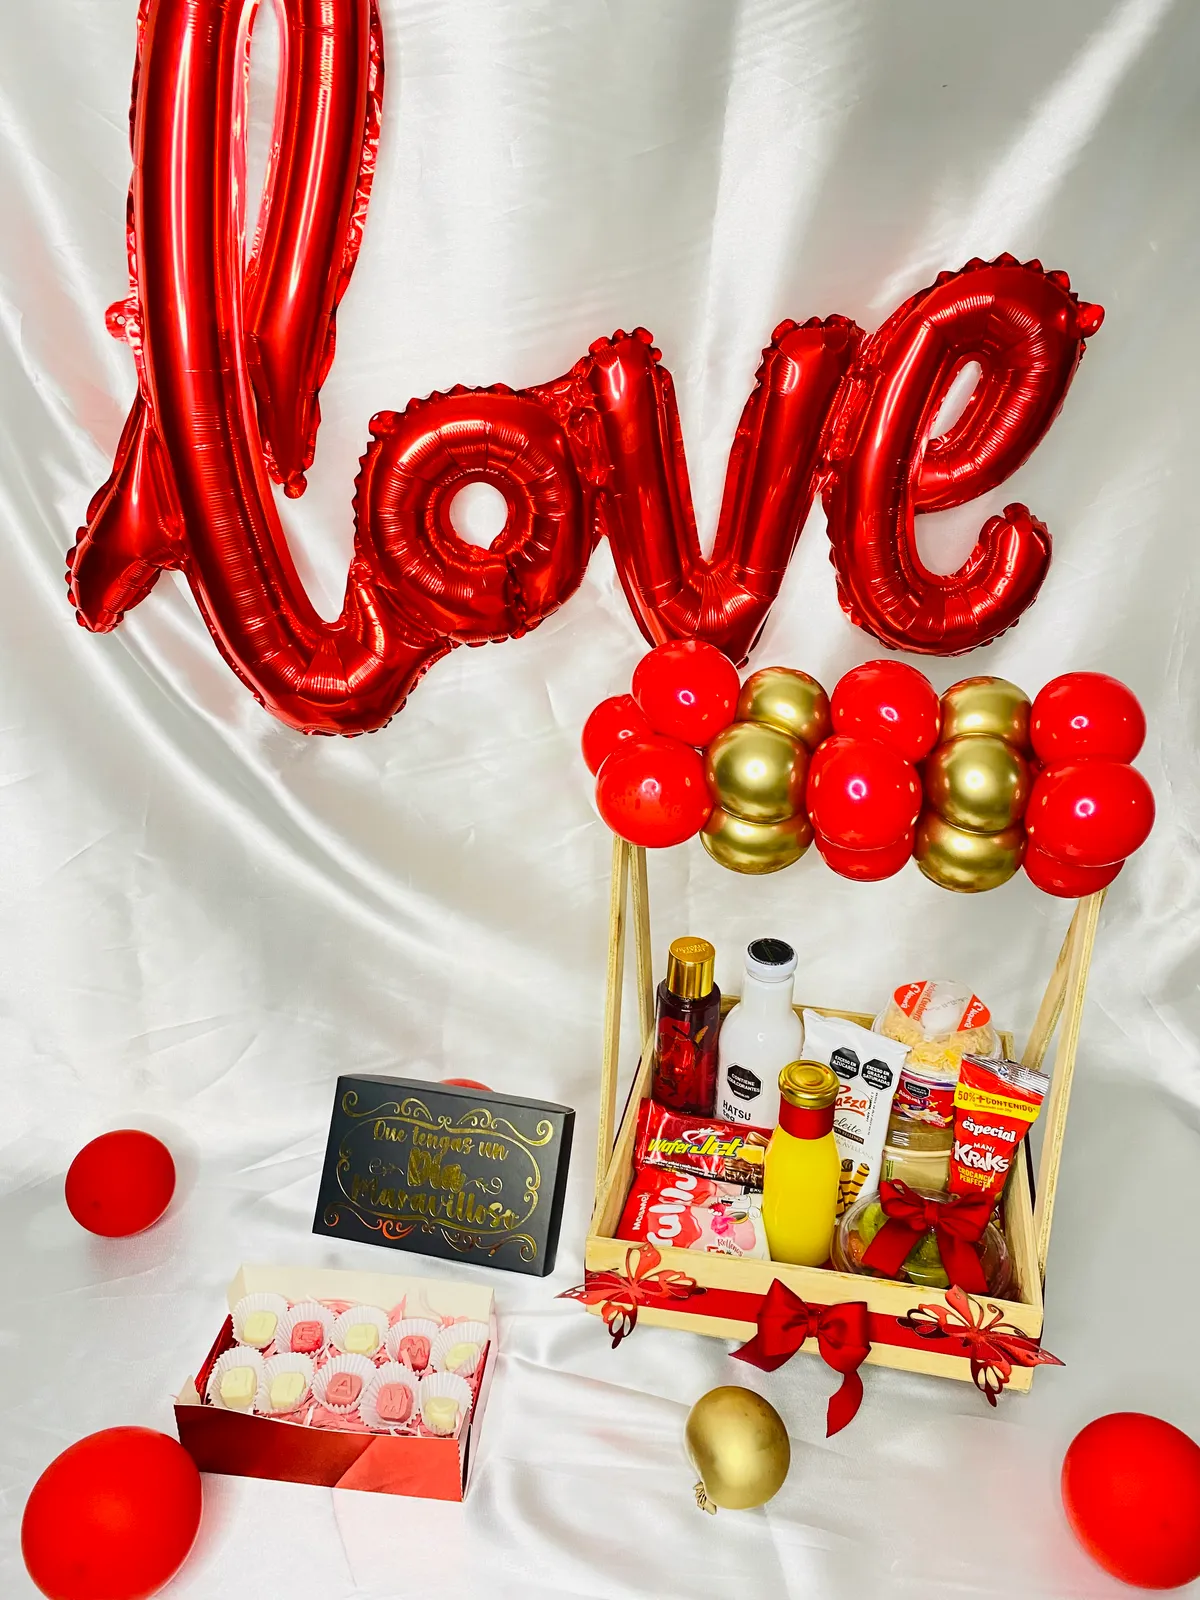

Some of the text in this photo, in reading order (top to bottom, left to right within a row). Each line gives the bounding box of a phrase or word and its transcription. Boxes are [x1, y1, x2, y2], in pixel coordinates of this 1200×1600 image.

[722, 1099, 751, 1121] HATSU
[722, 1109, 735, 1122] tea
[373, 1120, 509, 1161] Que tengas un
[962, 1119, 1016, 1142] especial
[647, 1135, 744, 1157] Wafer Jet
[351, 1173, 520, 1231] Maravilloso
[717, 1238, 744, 1257] Rellenos
